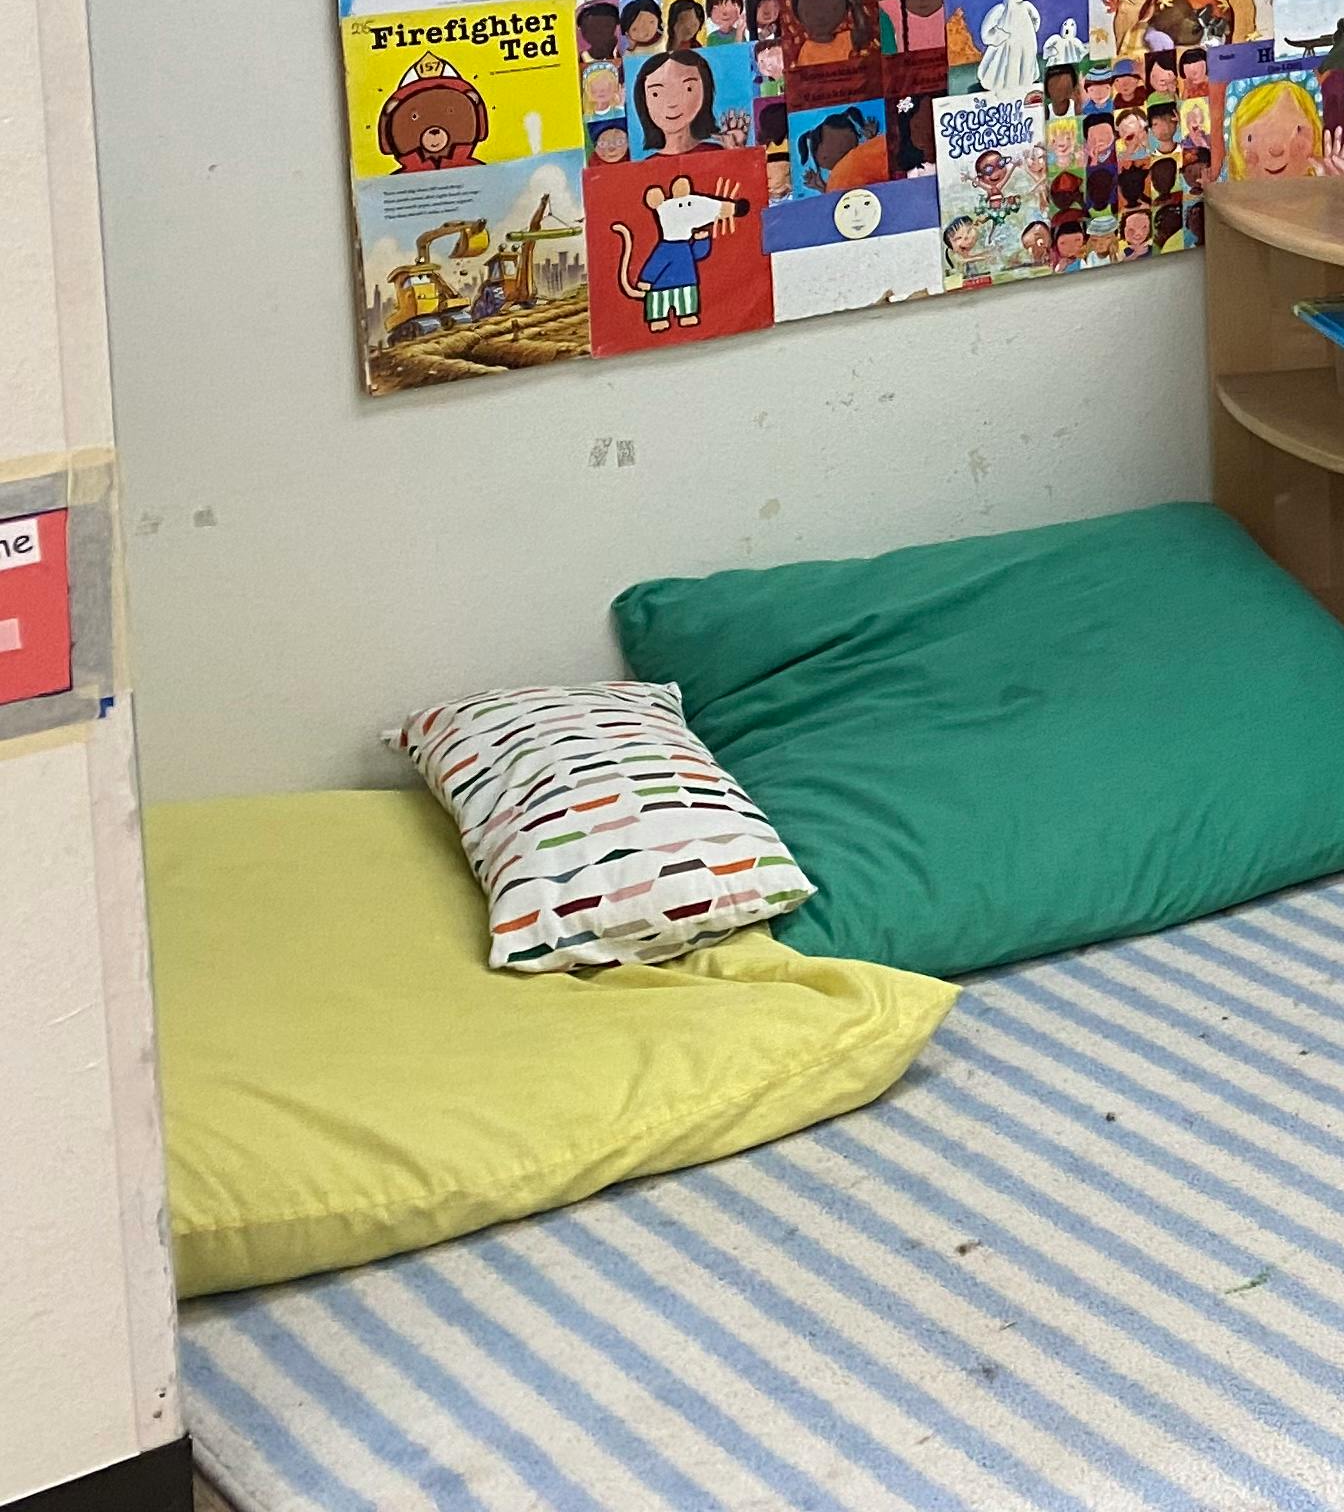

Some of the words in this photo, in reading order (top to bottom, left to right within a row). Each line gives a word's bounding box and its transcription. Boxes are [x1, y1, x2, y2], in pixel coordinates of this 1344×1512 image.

[371, 13, 558, 50] Firefighter
[500, 34, 559, 61] Ted
[420, 61, 440, 74] 157
[940, 99, 1022, 138] SPLISH!
[949, 117, 1034, 159] SPLASH!
